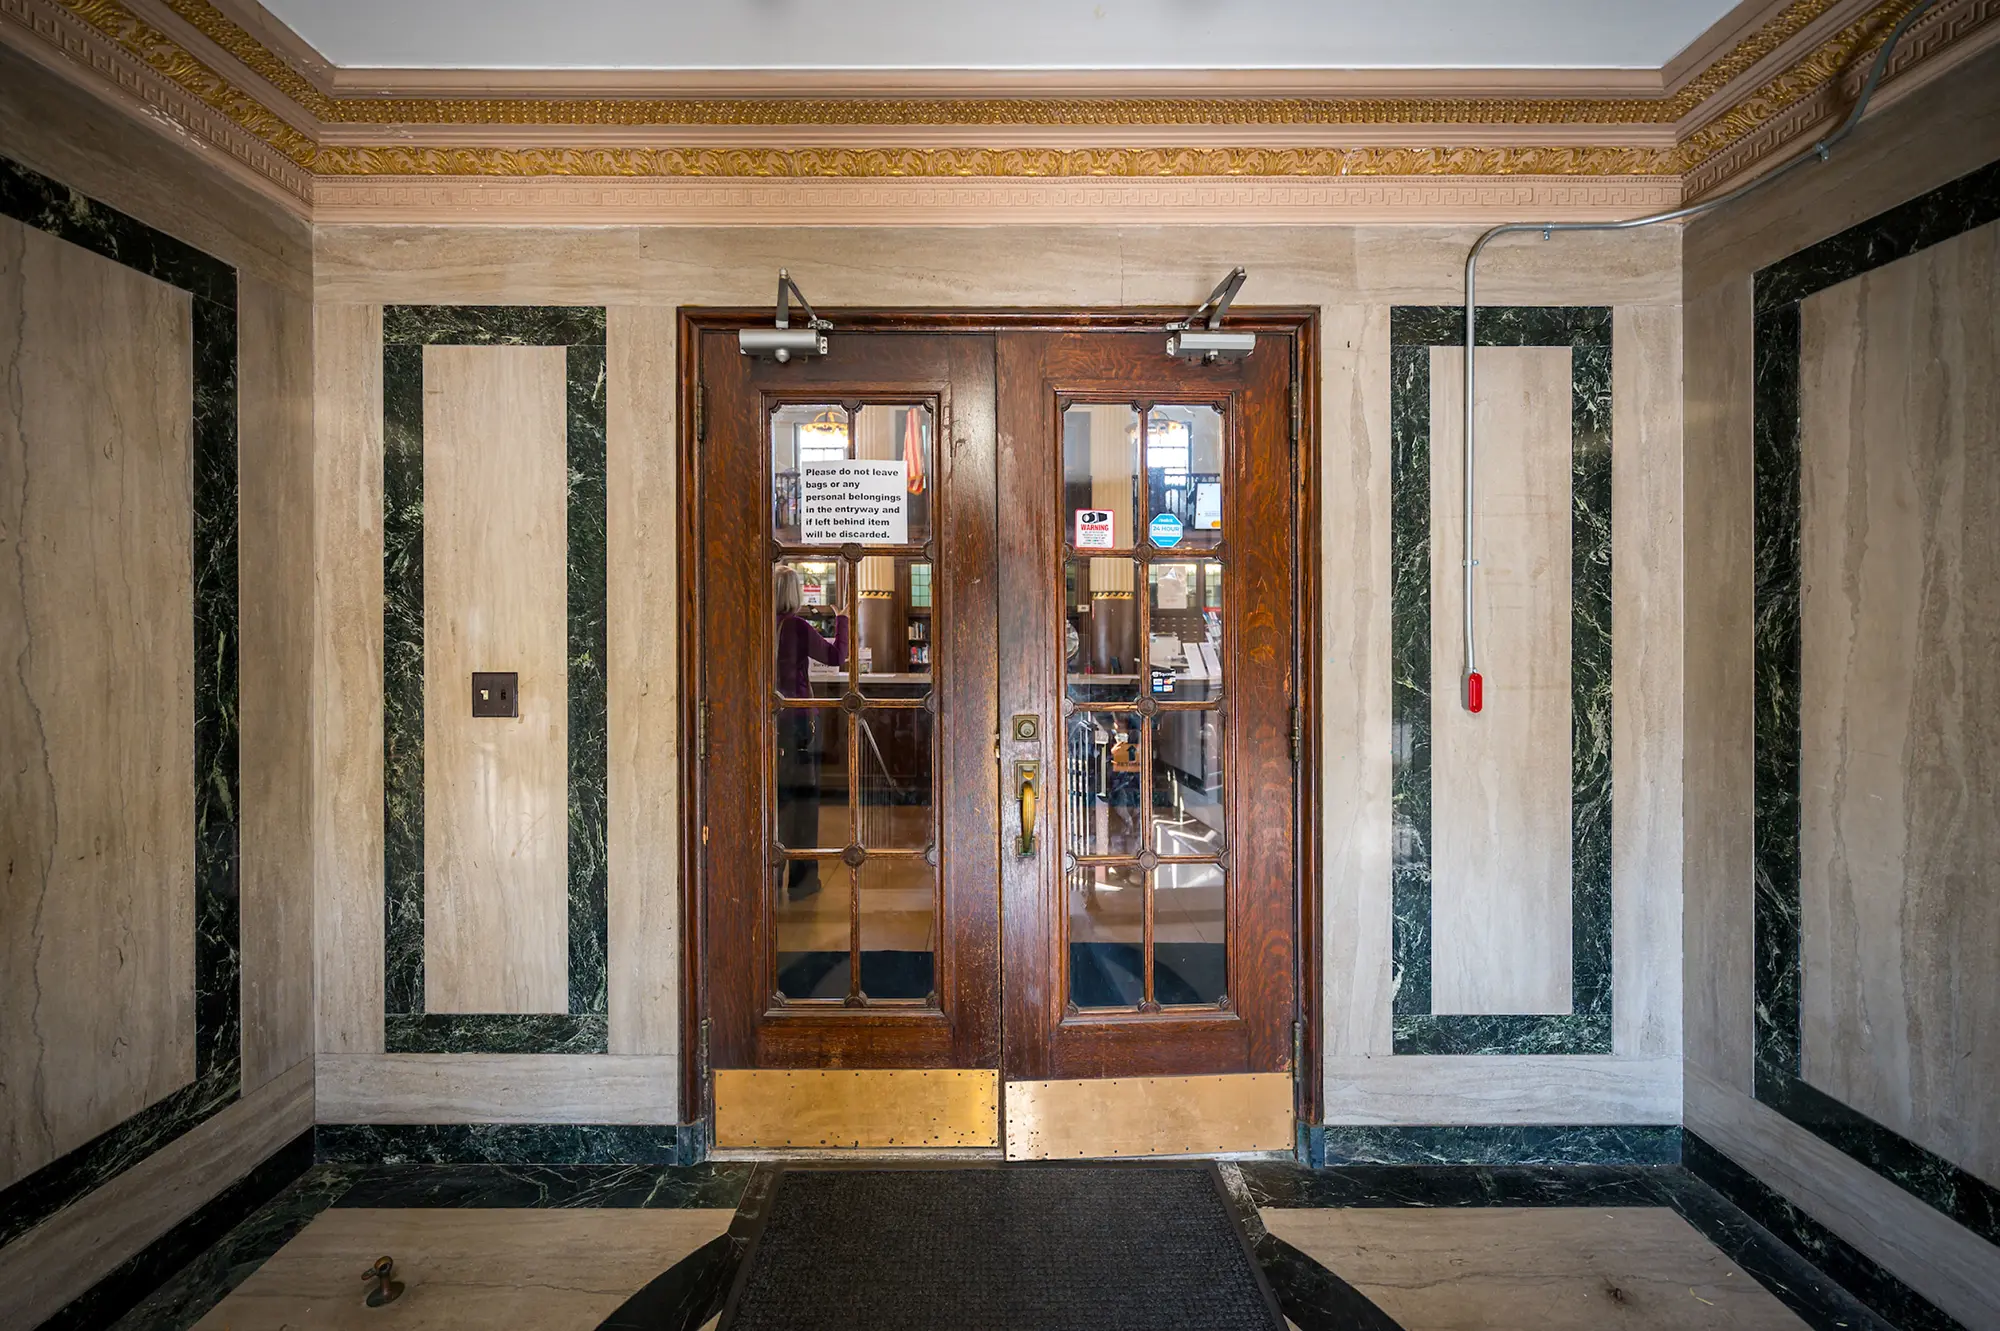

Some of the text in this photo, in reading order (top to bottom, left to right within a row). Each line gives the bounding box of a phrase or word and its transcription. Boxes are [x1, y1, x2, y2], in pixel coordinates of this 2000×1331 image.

[805, 469, 837, 477] Please
[838, 468, 852, 476] do
[872, 469, 899, 477] leave
[805, 481, 828, 491] bags
[842, 482, 861, 490] any
[805, 493, 902, 503] personal belongings
[805, 506, 815, 514] in
[816, 506, 833, 514] the
[834, 506, 880, 516] entryway
[805, 518, 890, 526] if left behind item
[1081, 523, 1109, 531] WARNING
[805, 531, 890, 539] will be discarded.
